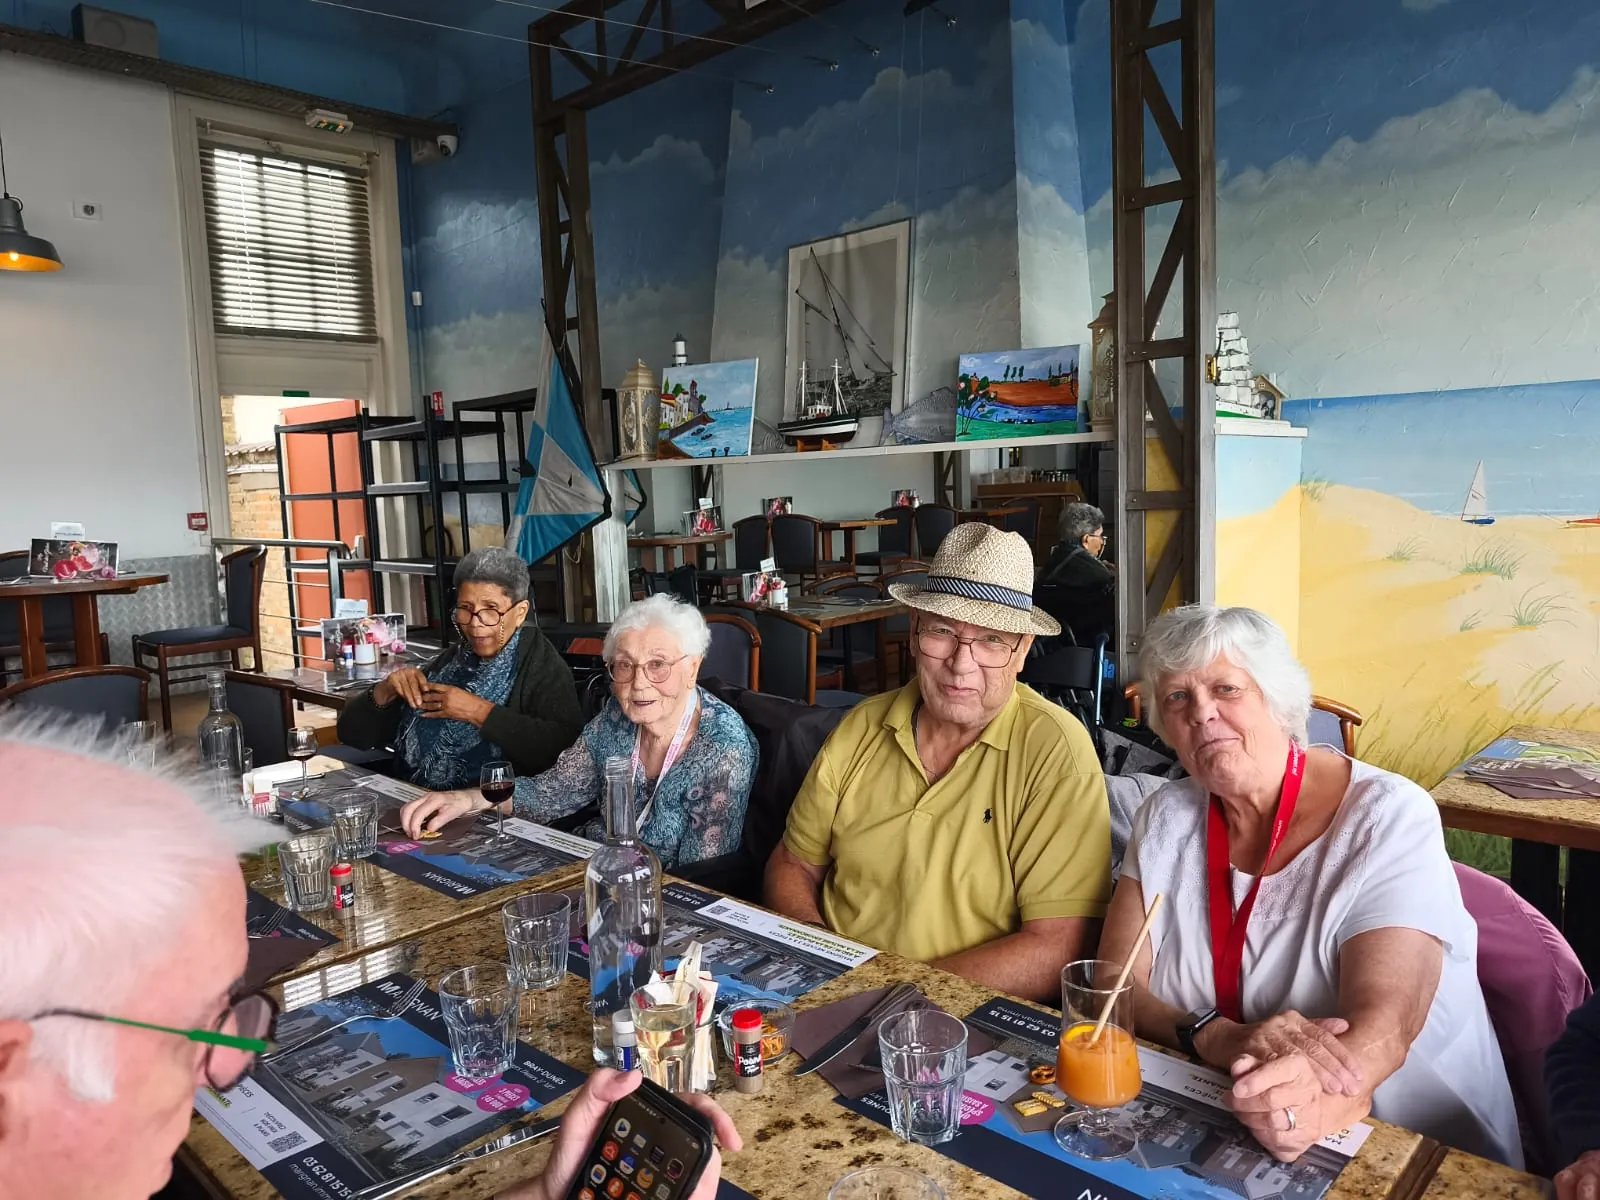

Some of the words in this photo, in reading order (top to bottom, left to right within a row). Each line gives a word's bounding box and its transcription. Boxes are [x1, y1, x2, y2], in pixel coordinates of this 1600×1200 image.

[1026, 1023, 1040, 1032] 62
[1040, 1029, 1056, 1037] 03
[303, 1156, 319, 1168] 03
[312, 1165, 328, 1176] 62
[321, 1172, 336, 1183] 81
[329, 1180, 345, 1190] 15
[337, 1187, 352, 1198] 15
